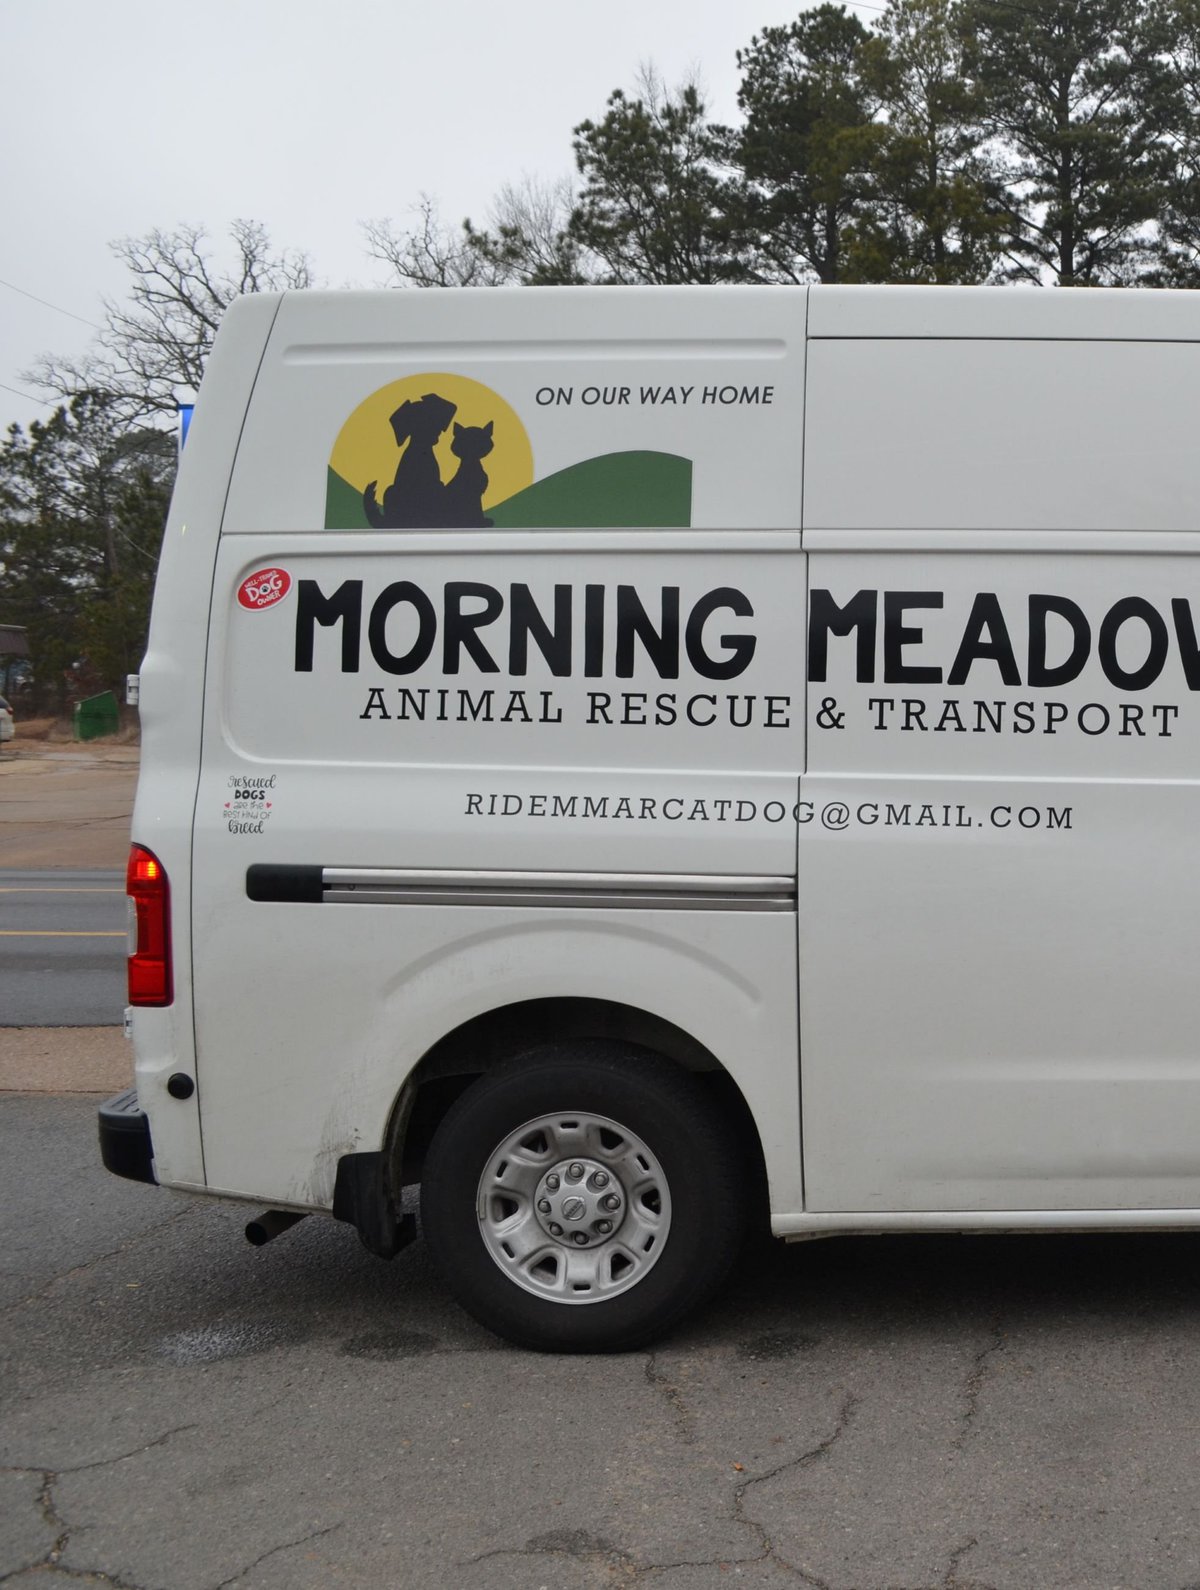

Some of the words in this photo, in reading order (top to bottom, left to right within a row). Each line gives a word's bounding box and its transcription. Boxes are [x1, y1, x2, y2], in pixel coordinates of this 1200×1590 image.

[535, 387, 574, 406] ON
[581, 386, 631, 406] OUR
[639, 386, 695, 405] WAY
[701, 385, 774, 405] HOME
[245, 574, 282, 602] DOG
[294, 579, 757, 681] MORNING
[359, 687, 563, 724] ANIMAL
[585, 691, 791, 729] RESCUE
[815, 696, 846, 730] &
[866, 697, 1179, 737] TRANSPORT
[235, 789, 265, 800] DOGS
[464, 793, 1073, 831] RIDEMMARCATDOG@GMAIL.COM
